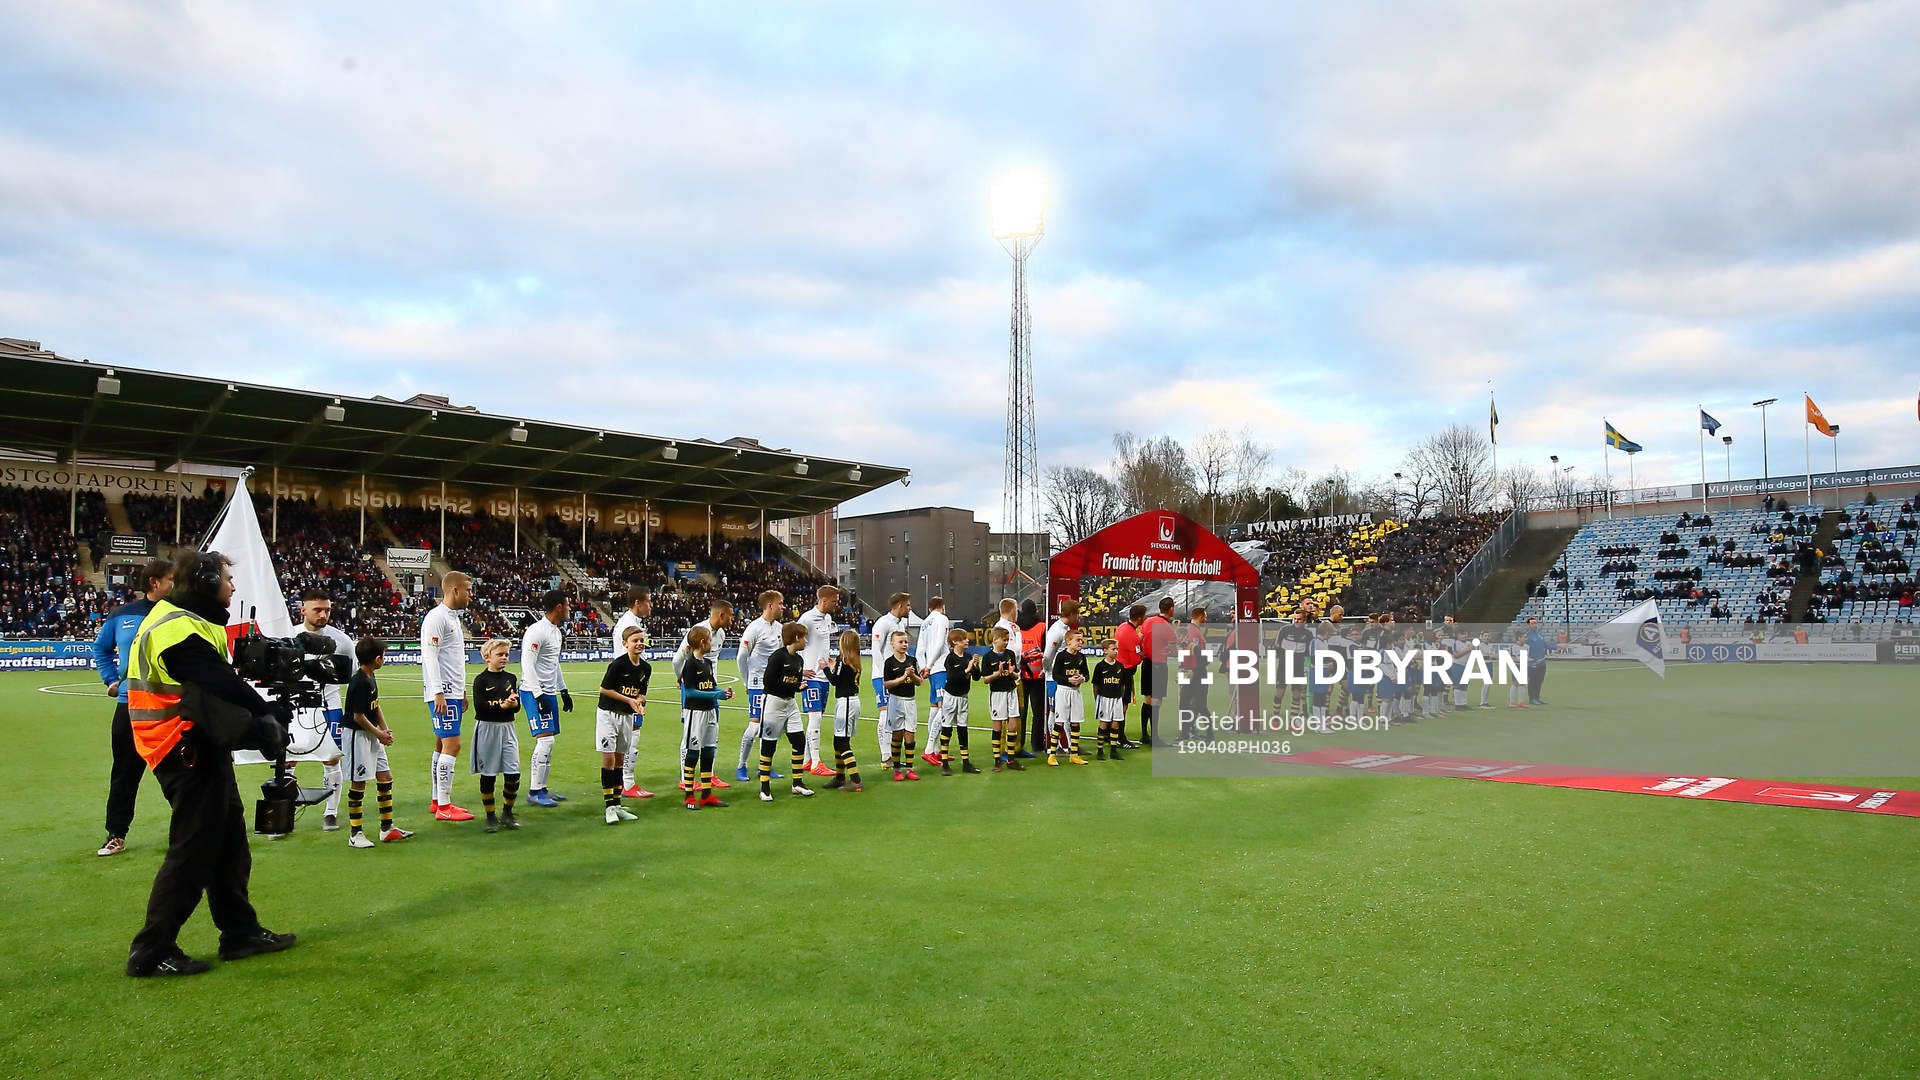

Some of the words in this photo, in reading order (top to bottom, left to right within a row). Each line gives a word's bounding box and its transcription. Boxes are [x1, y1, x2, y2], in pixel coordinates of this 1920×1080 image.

[1708, 485, 1719, 494] Vi
[1721, 484, 1754, 493] flyttar
[1755, 482, 1774, 490] alla
[1776, 478, 1806, 491] dagar
[1831, 475, 1851, 485] inte
[1855, 472, 1888, 486] spelar
[342, 487, 401, 508] 1960
[1102, 552, 1139, 571] Framåt
[1141, 555, 1157, 571] för
[1157, 558, 1187, 574] svensk
[1189, 558, 1221, 576] fotboll!
[1103, 676, 1120, 684] notar
